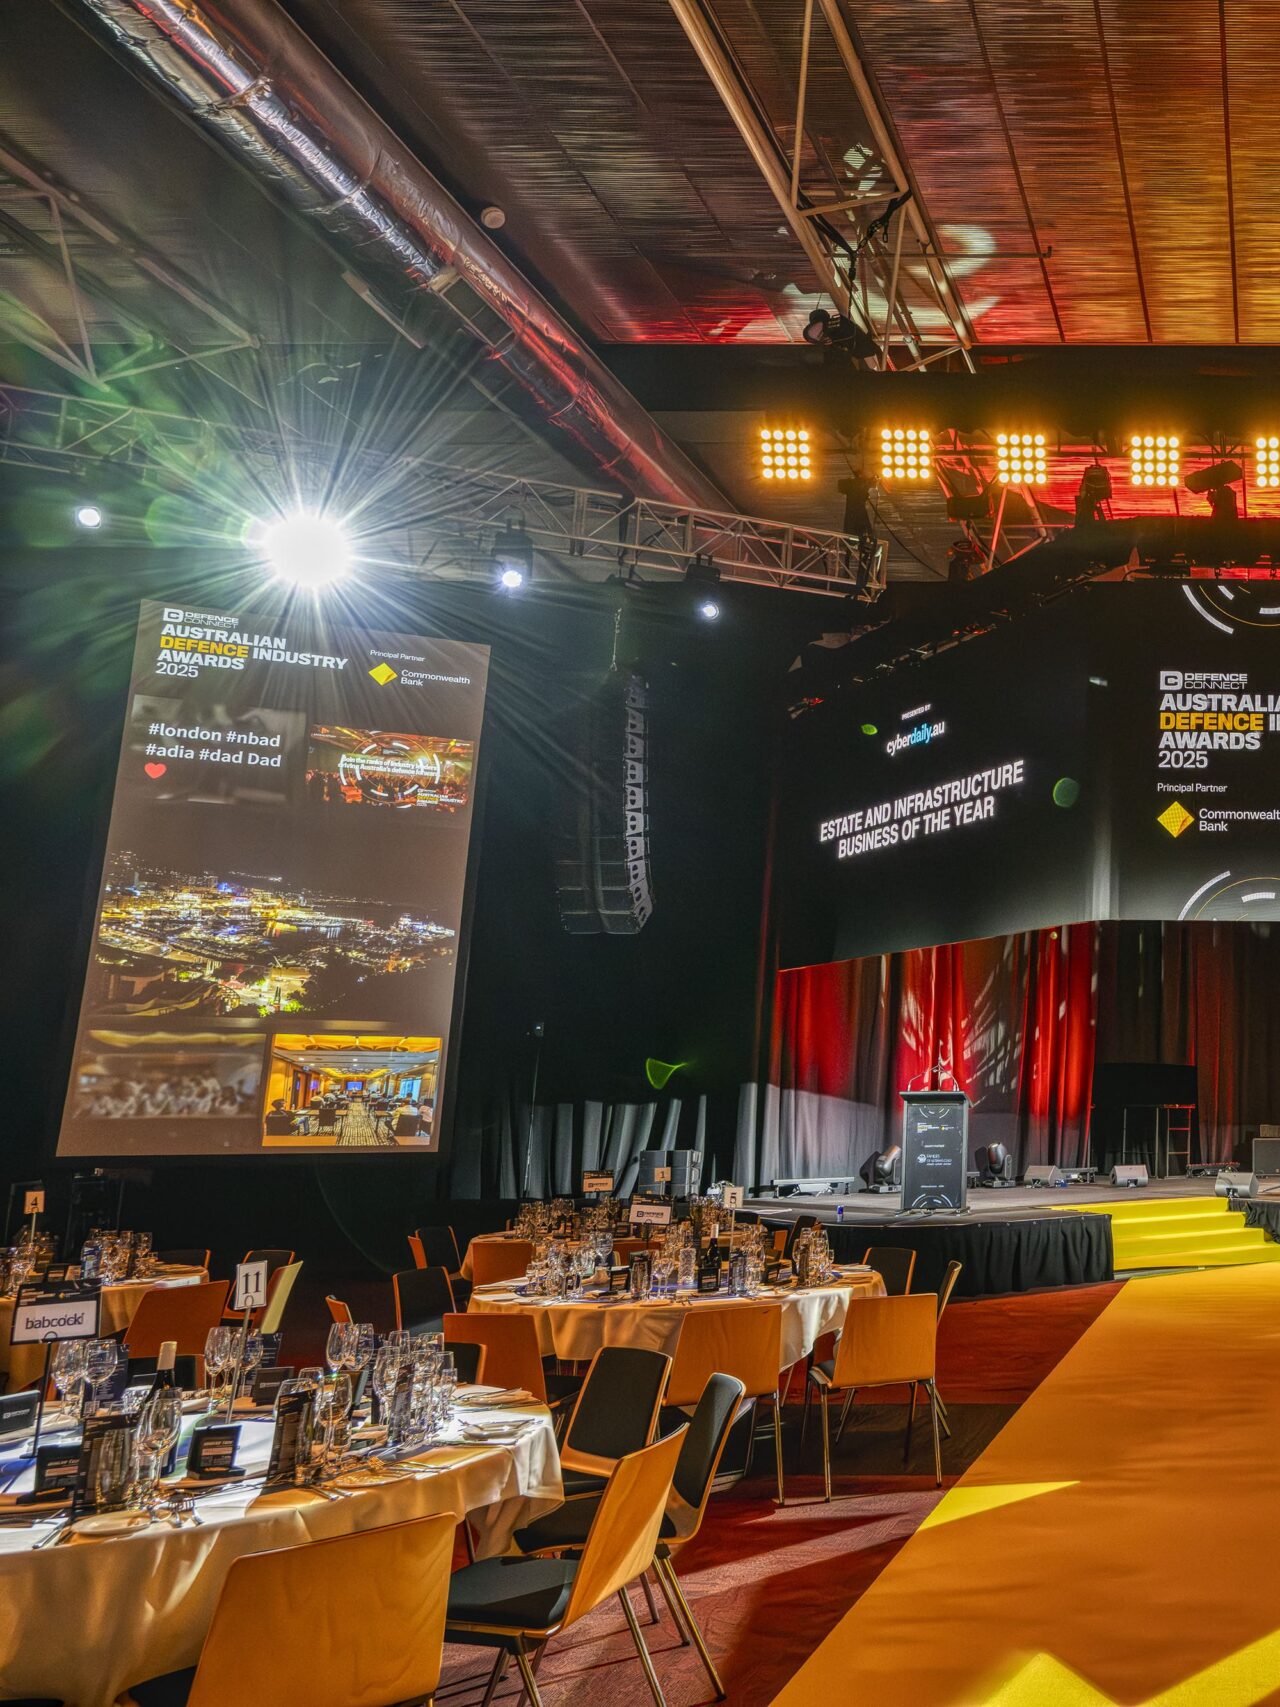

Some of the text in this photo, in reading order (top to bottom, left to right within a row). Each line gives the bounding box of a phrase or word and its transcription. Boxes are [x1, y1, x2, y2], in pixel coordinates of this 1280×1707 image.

[184, 618, 239, 628] CONNECT
[185, 612, 239, 623] DEFENCE
[161, 624, 286, 650] AUSTRALIAN
[157, 650, 245, 670] AWARDS
[160, 636, 348, 670] DEFENCE INDUSTRY
[370, 650, 426, 662] Principal Partner
[156, 662, 199, 678] 2025
[402, 670, 470, 684] Commonwealth
[1184, 673, 1248, 682] DEFENCE
[401, 677, 423, 686] Bank
[1184, 681, 1248, 690] CONNECT
[1160, 712, 1264, 731] DEFENCE
[148, 722, 280, 747] #london #nbad
[886, 722, 944, 756] cyberdaily.au
[1158, 732, 1260, 750] AWARDS
[146, 744, 282, 768] #adia #dad Dad
[1158, 751, 1208, 768] 2025
[1157, 783, 1228, 794] Principal Partner
[820, 760, 1024, 842] ESTATE AND INFRASTRUCTURE
[838, 796, 994, 858] BUSINESS OF THE YEAR
[1200, 821, 1228, 832] Bank
[660, 1170, 666, 1179] 1
[31, 1196, 38, 1206] 4
[730, 1192, 737, 1204] 5
[242, 1270, 262, 1294] 11
[25, 1313, 84, 1330] babcock
